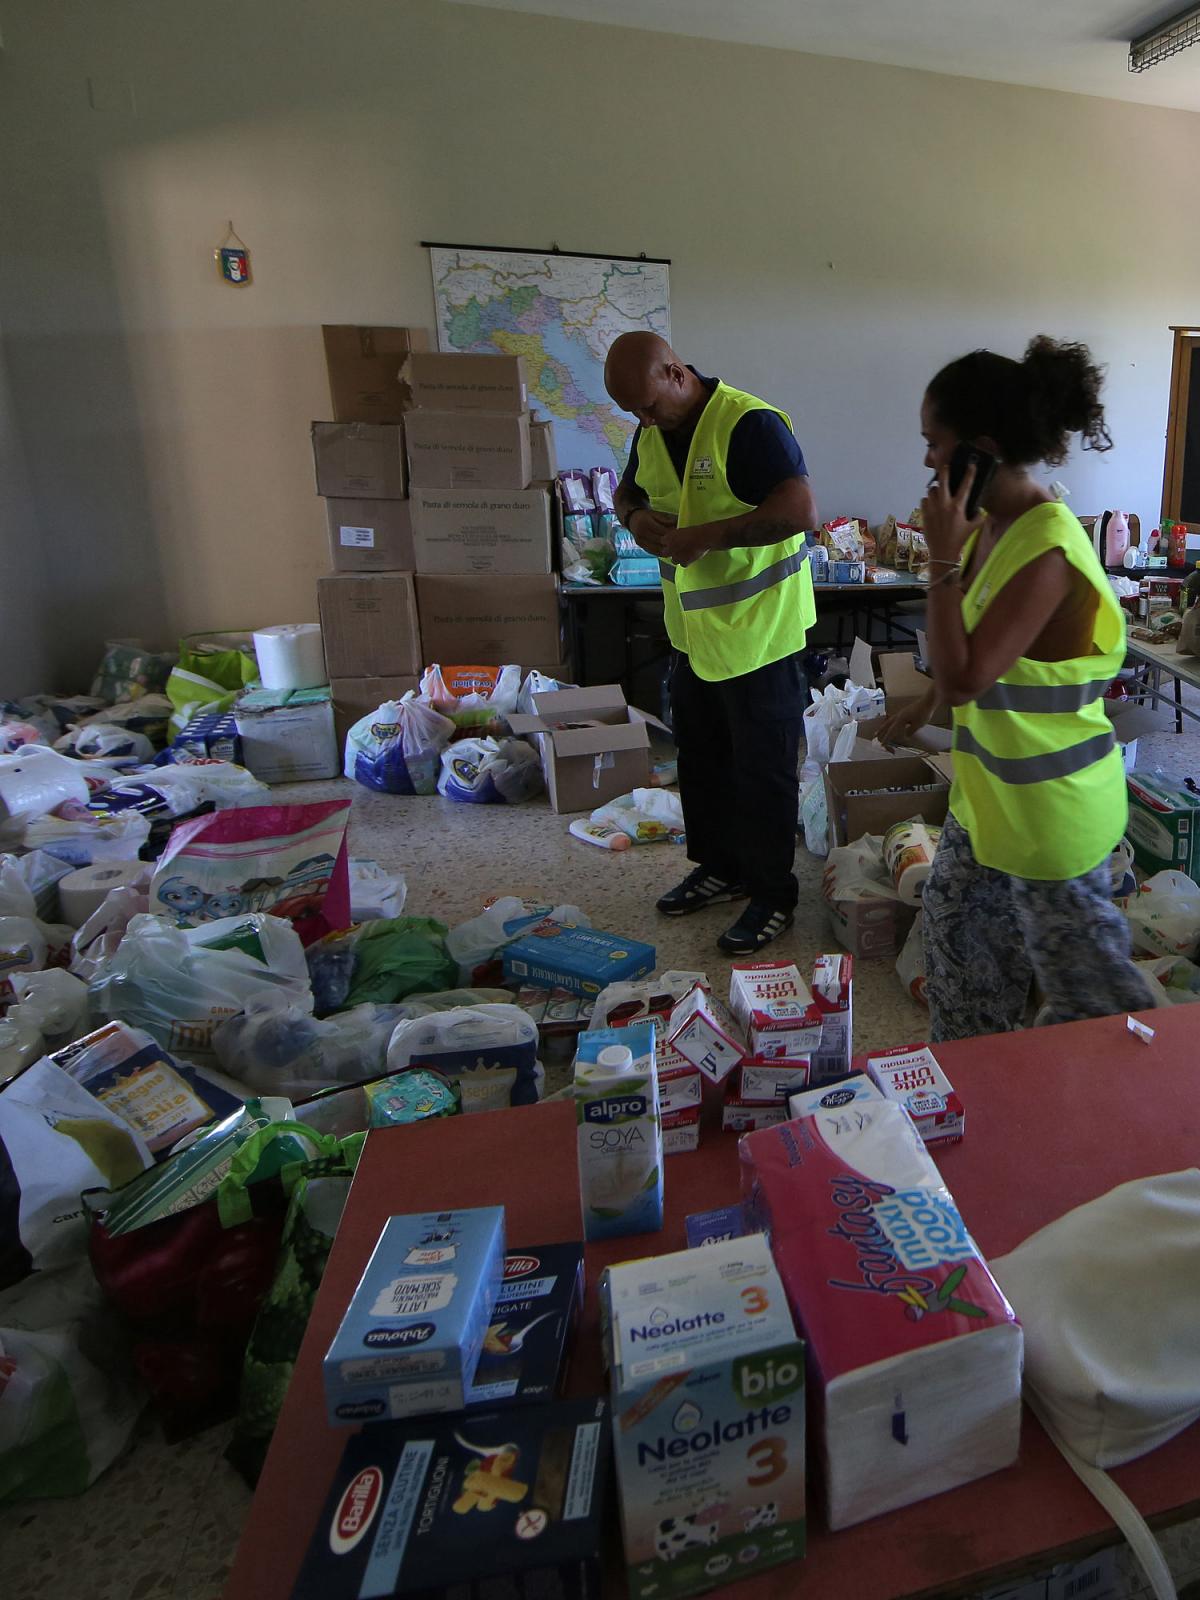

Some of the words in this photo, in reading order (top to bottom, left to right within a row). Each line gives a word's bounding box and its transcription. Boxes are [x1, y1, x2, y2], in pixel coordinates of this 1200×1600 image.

[422, 501, 441, 509] Pasta
[443, 501, 451, 509] di
[490, 503, 511, 511] grano
[512, 502, 530, 510] duro
[454, 615, 462, 623] di
[465, 615, 492, 623] semola
[495, 615, 502, 623] di
[504, 617, 529, 625] grano
[529, 615, 547, 623] duro
[744, 971, 791, 980] Scremato
[753, 980, 795, 992] UHT
[756, 990, 798, 1000] Latte
[880, 1055, 926, 1069] Scremato
[891, 1067, 932, 1083] UHT
[894, 1075, 936, 1092] Latte
[590, 1098, 643, 1121] alpro
[590, 1126, 645, 1150] SOYA
[828, 1174, 934, 1294] fantasy
[879, 1203, 933, 1265] maxi
[895, 1191, 974, 1256] food
[504, 1259, 534, 1274] rilla
[393, 1279, 443, 1296] SCREMATO
[500, 1280, 545, 1294] LUTINE
[394, 1300, 428, 1315] LATTE
[740, 1285, 771, 1316] 3
[367, 1323, 432, 1344] Arborea
[630, 1311, 726, 1343] Neolatte
[741, 1360, 799, 1398] bio
[637, 1405, 793, 1468] Neolatte
[746, 1435, 788, 1488] 3
[340, 1473, 376, 1533] Barilla
[375, 1509, 399, 1559] SENZA
[391, 1449, 419, 1508] GLUTINE
[416, 1456, 450, 1536] TORTIGLIONI
